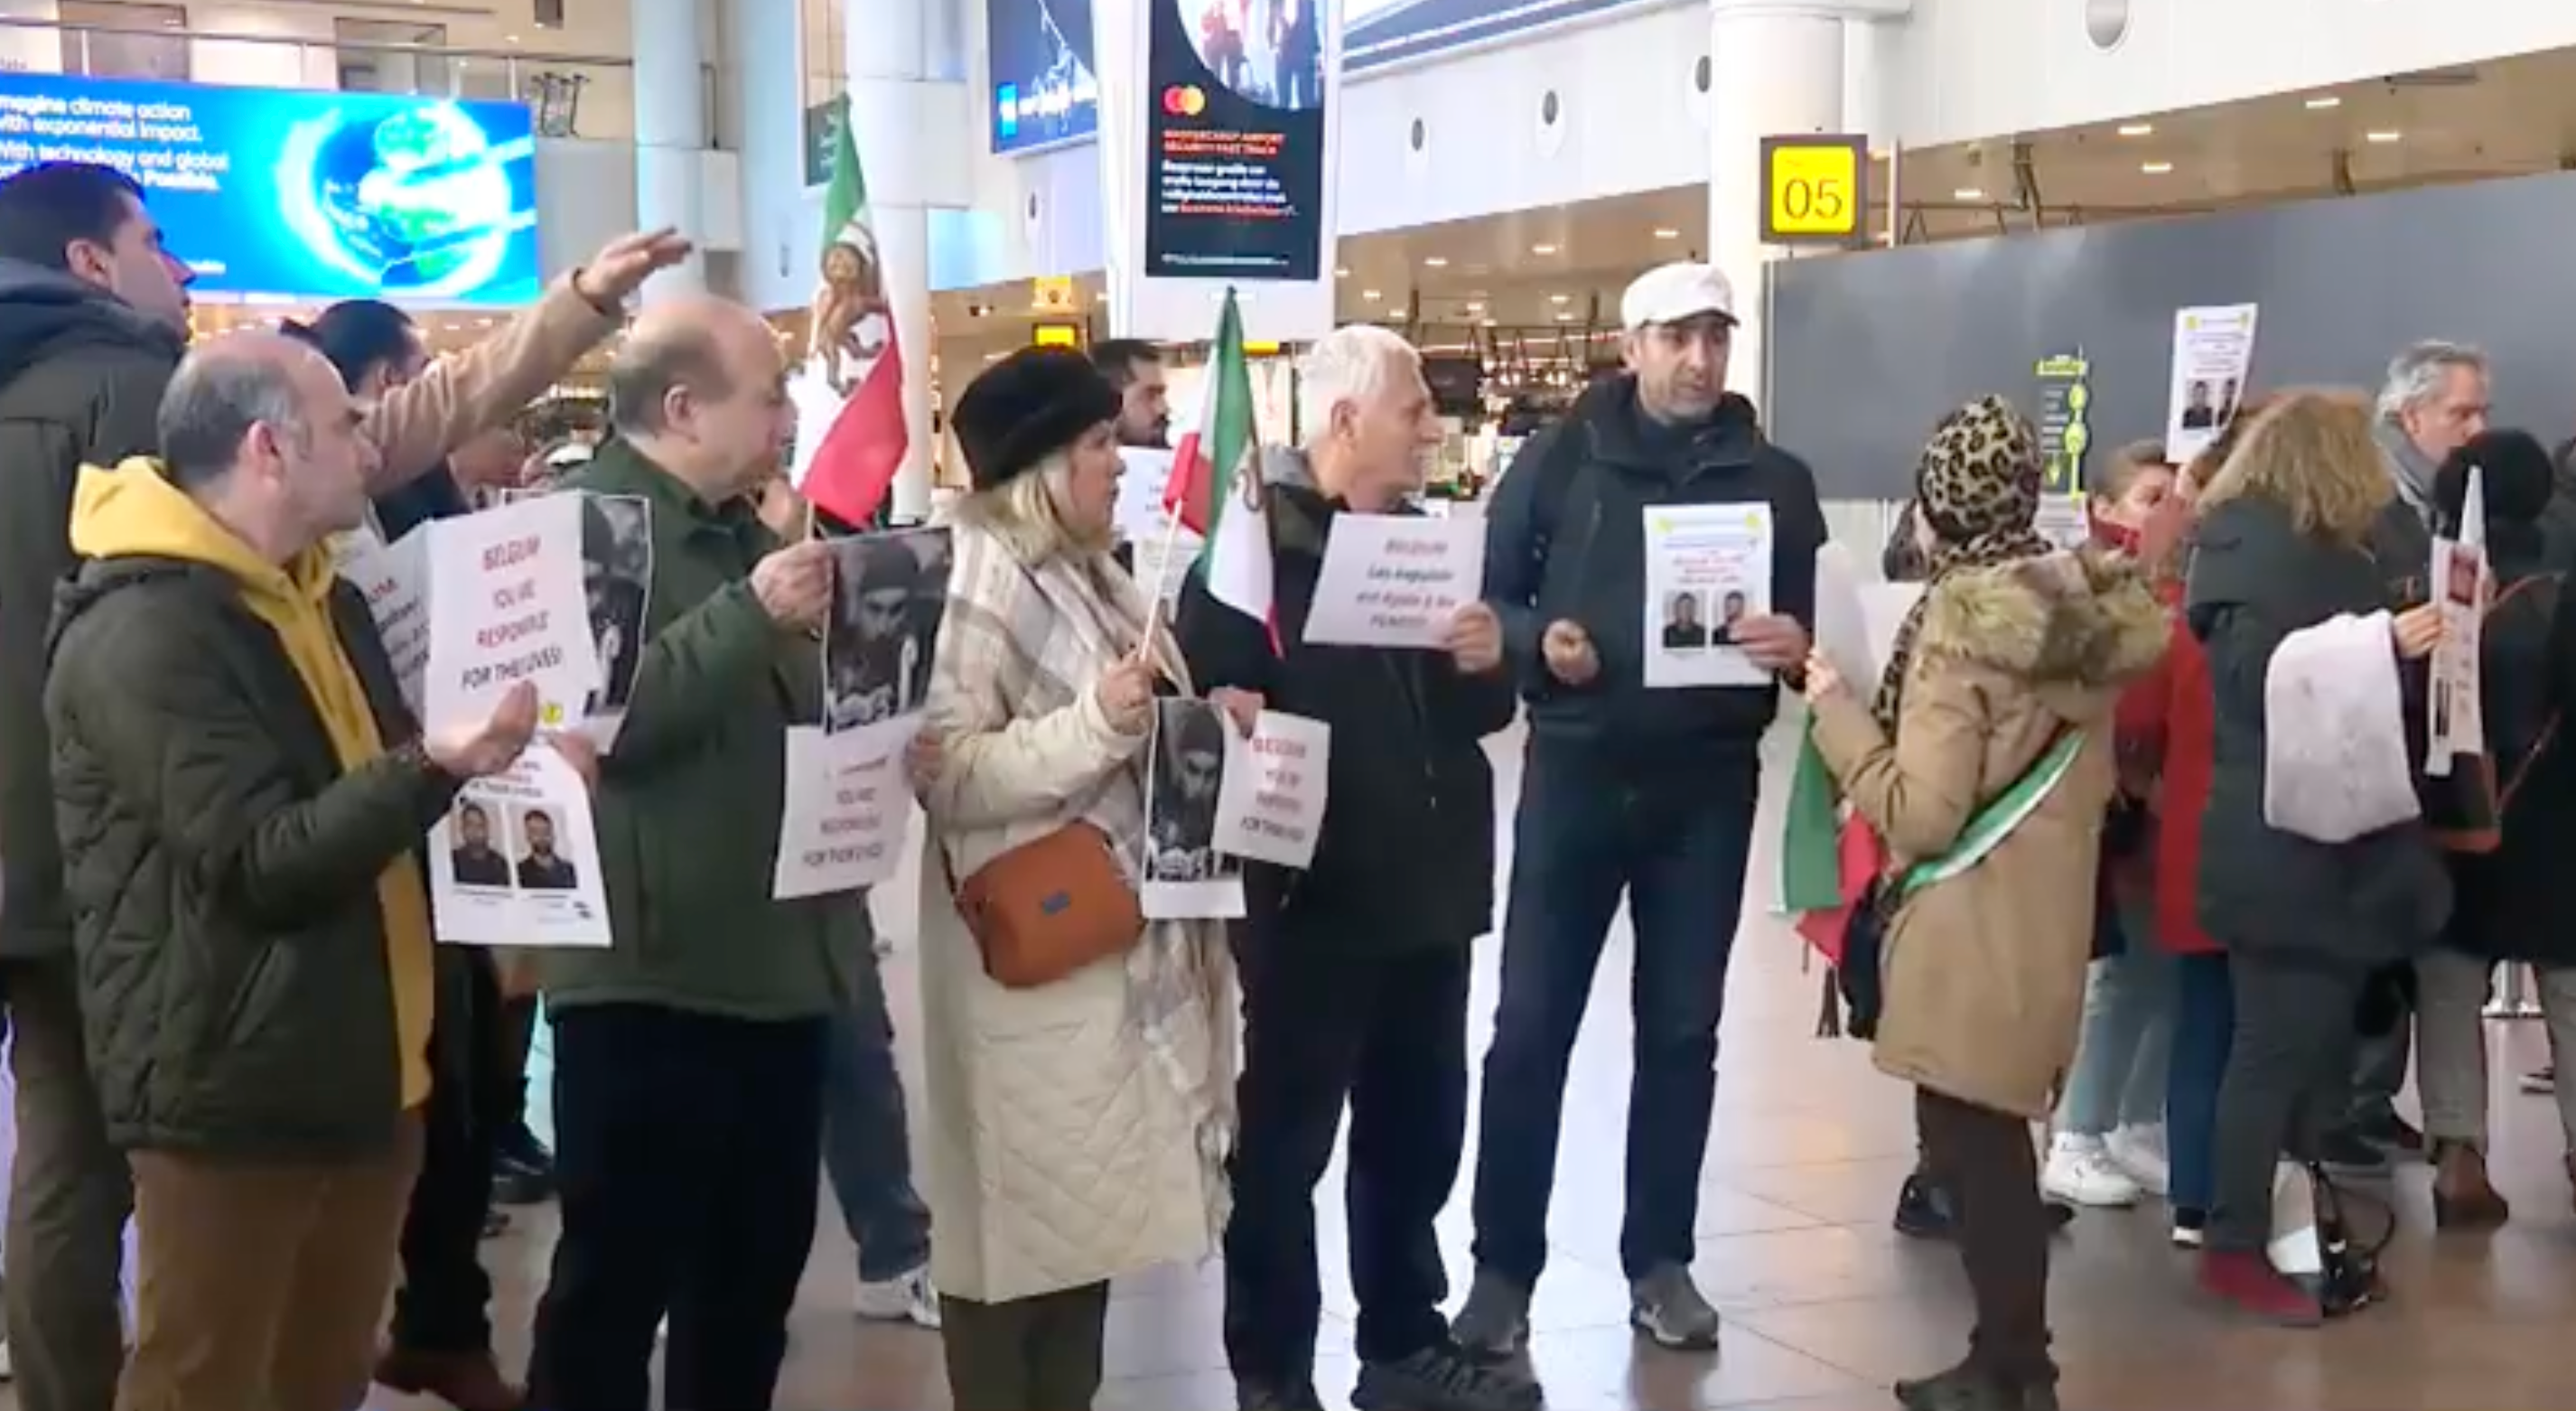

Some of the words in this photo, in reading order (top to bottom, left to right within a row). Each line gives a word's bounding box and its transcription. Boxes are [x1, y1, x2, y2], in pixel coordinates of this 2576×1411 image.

[0, 95, 67, 116] magine
[69, 98, 135, 118] climate
[136, 101, 191, 121] action
[33, 118, 135, 140] exponential
[139, 121, 203, 142] impact.
[39, 145, 135, 172] technology
[137, 149, 173, 168] and
[175, 151, 229, 173] global
[1783, 178, 1843, 220] 05
